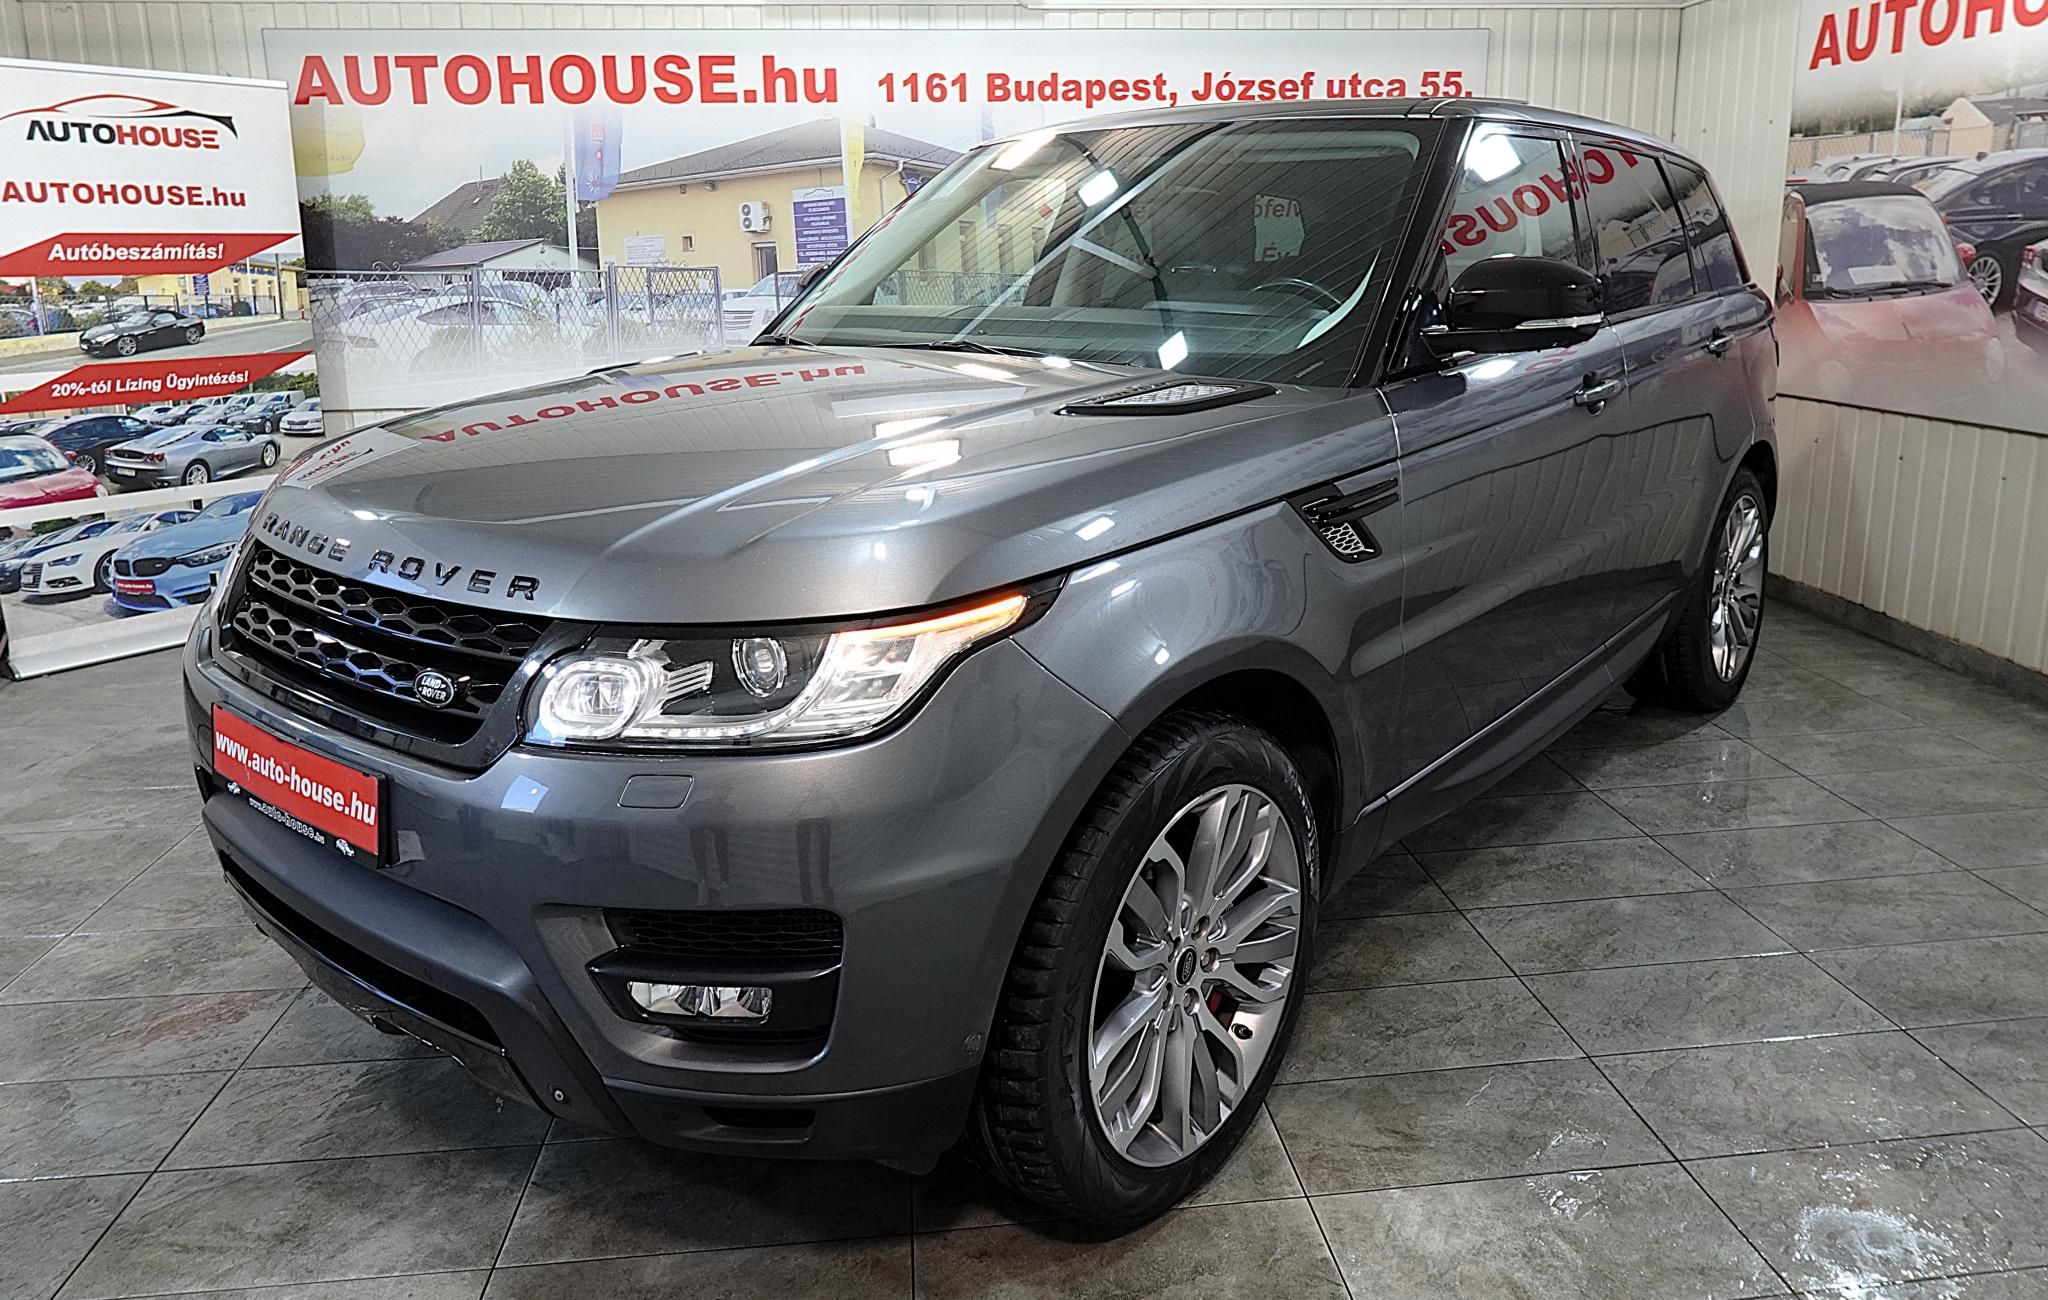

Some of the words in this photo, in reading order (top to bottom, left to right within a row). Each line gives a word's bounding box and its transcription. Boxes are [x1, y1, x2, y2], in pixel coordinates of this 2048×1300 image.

[294, 54, 838, 106] AUTOHOUSE.hu
[878, 73, 967, 103] 1161
[986, 73, 1177, 108] Budapest,
[1191, 71, 1315, 101] József
[1326, 73, 1407, 98] utca
[1420, 71, 1473, 97] 55.
[26, 120, 220, 149] AUTOHOUSE
[2, 181, 247, 207] AUTOHOUSE.hu
[48, 243, 224, 262] Autóbeszámítás!
[51, 379, 112, 397] 20%-tól
[115, 378, 162, 392] Lízing
[166, 371, 249, 390] Ügyintézés!
[262, 511, 351, 562] RANGE
[368, 549, 540, 601] ROVER
[421, 676, 442, 689] LAND
[421, 686, 447, 701] ROVER
[215, 731, 376, 826] www.auto-house.hu
